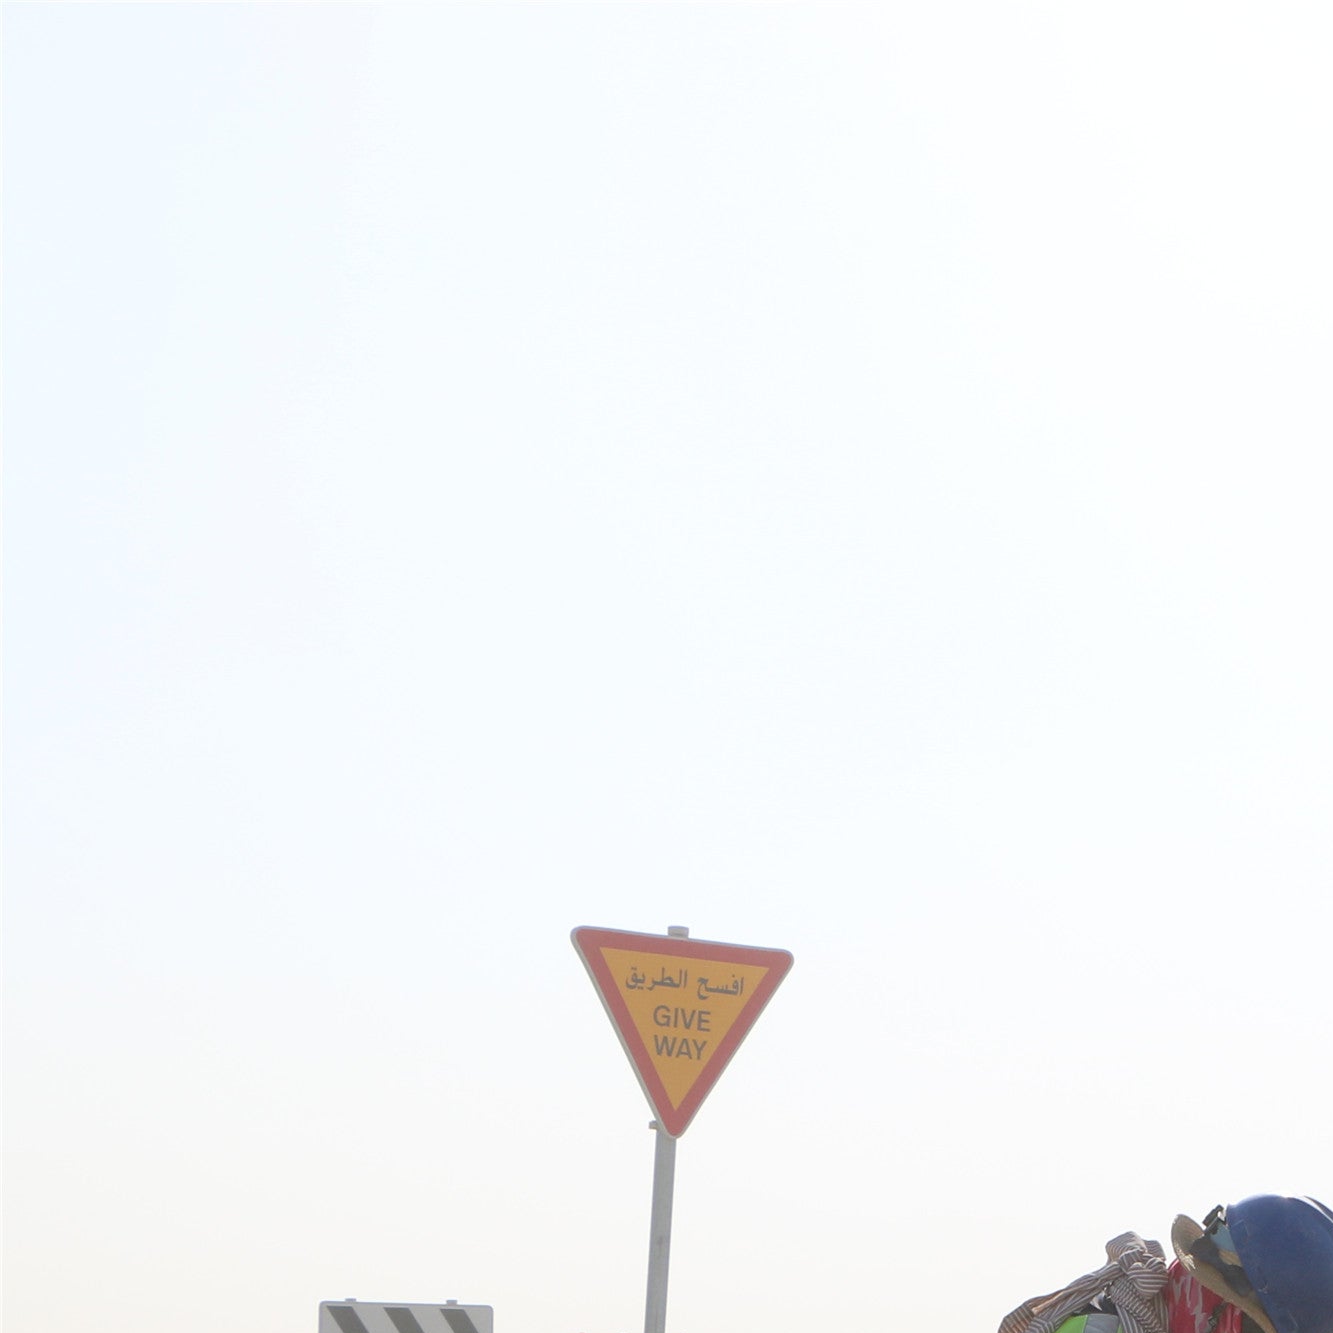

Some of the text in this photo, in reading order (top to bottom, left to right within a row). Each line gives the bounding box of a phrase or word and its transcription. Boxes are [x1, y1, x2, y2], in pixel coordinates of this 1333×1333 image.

[625, 967, 745, 1000] افسح الطريق
[653, 1005, 711, 1032] GIVE
[653, 1034, 707, 1061] WAY
